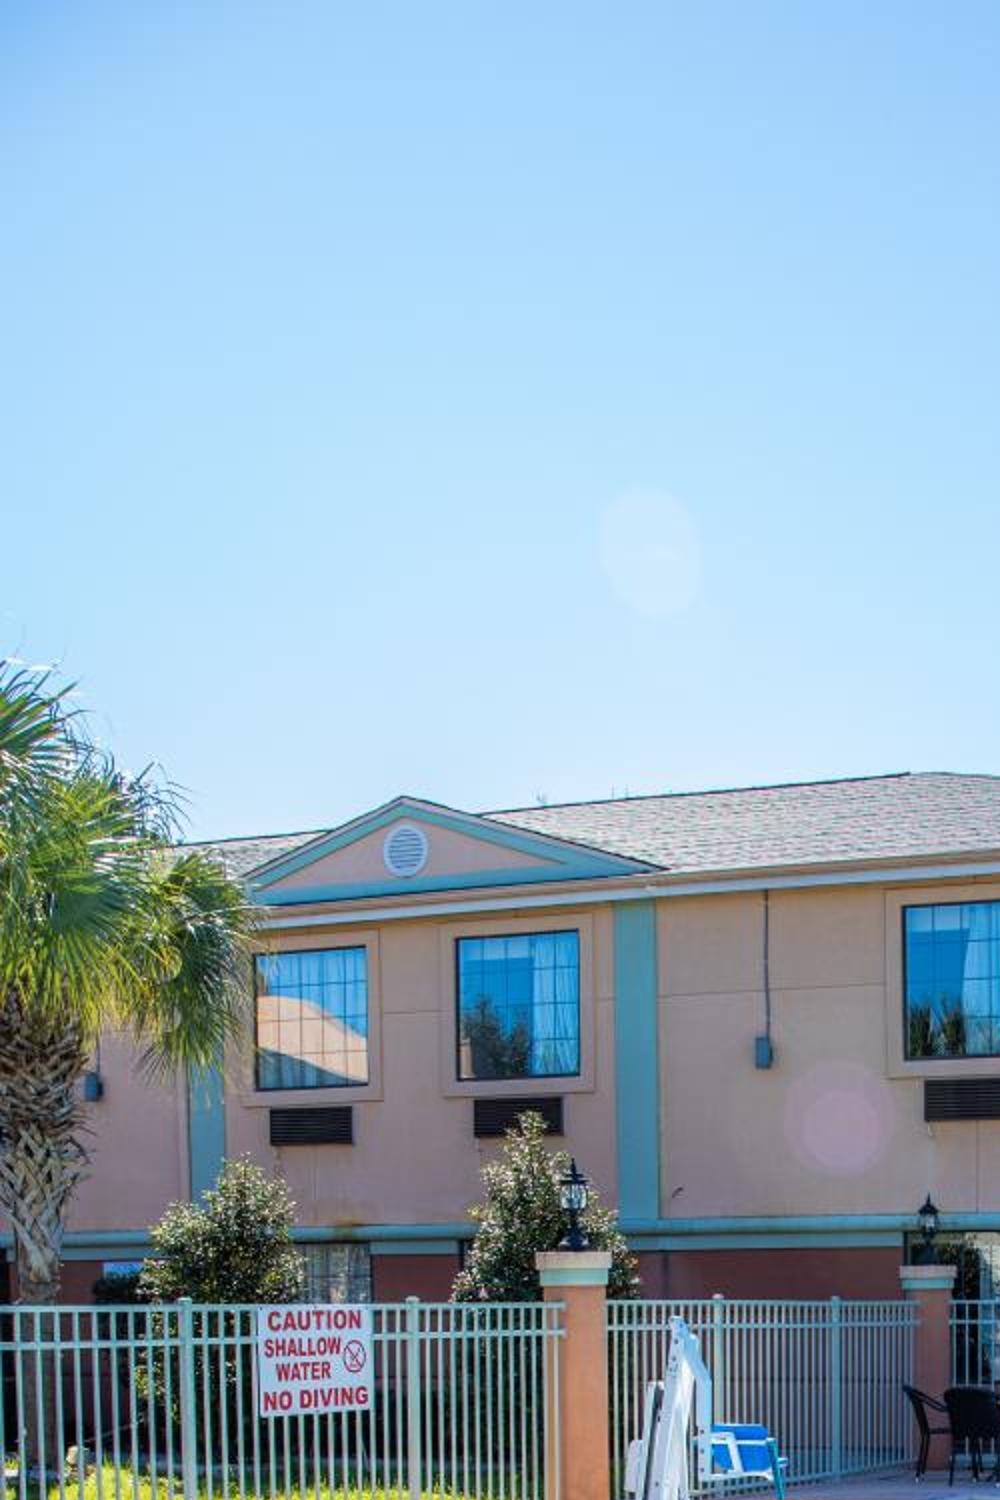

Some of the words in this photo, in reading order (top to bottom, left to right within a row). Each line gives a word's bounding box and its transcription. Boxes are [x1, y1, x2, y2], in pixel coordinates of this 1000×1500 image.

[267, 1310, 362, 1331] CAUTION
[264, 1337, 341, 1358] SHALLOW
[276, 1361, 331, 1381] WATER
[263, 1390, 293, 1411] NO
[299, 1386, 369, 1409] DIVING
